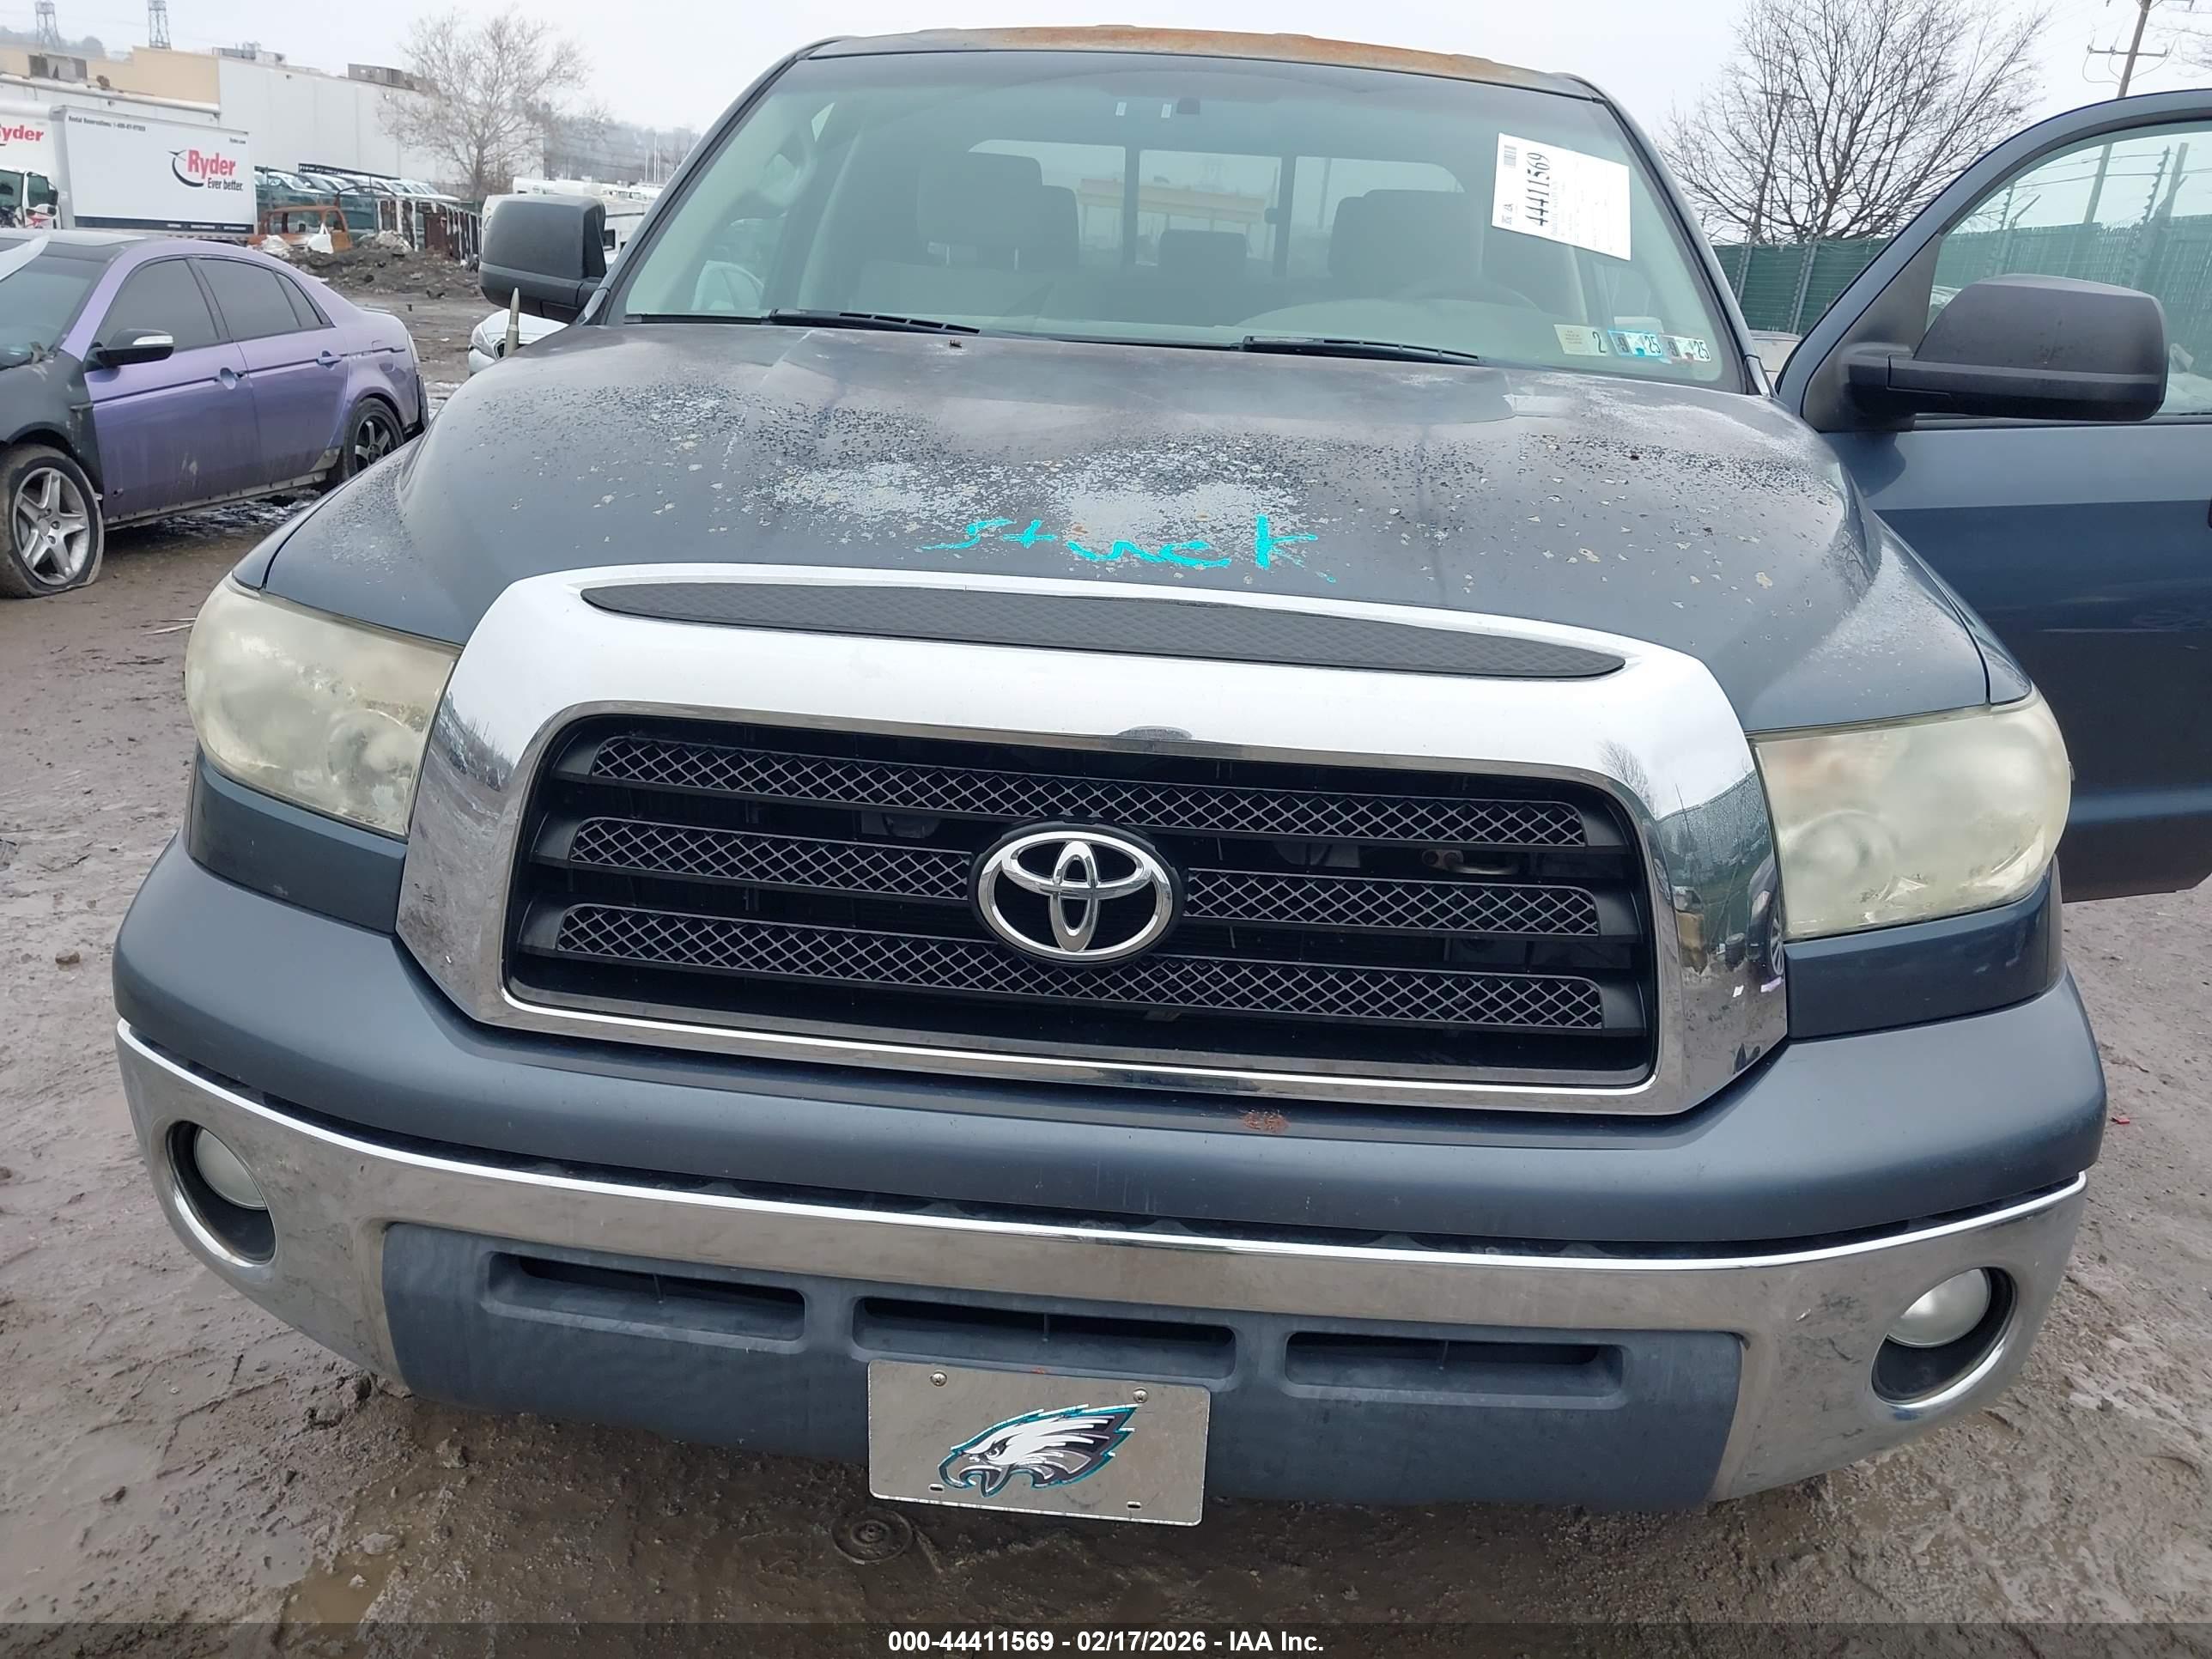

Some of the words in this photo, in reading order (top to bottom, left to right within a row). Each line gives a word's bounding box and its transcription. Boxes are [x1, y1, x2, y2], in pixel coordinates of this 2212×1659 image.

[0, 125, 44, 142] yder
[188, 149, 235, 179] Ryder
[207, 177, 222, 189] Ever
[1525, 152, 1550, 226] 44411569
[1644, 335, 1662, 354] 25
[1693, 340, 1711, 359] 25
